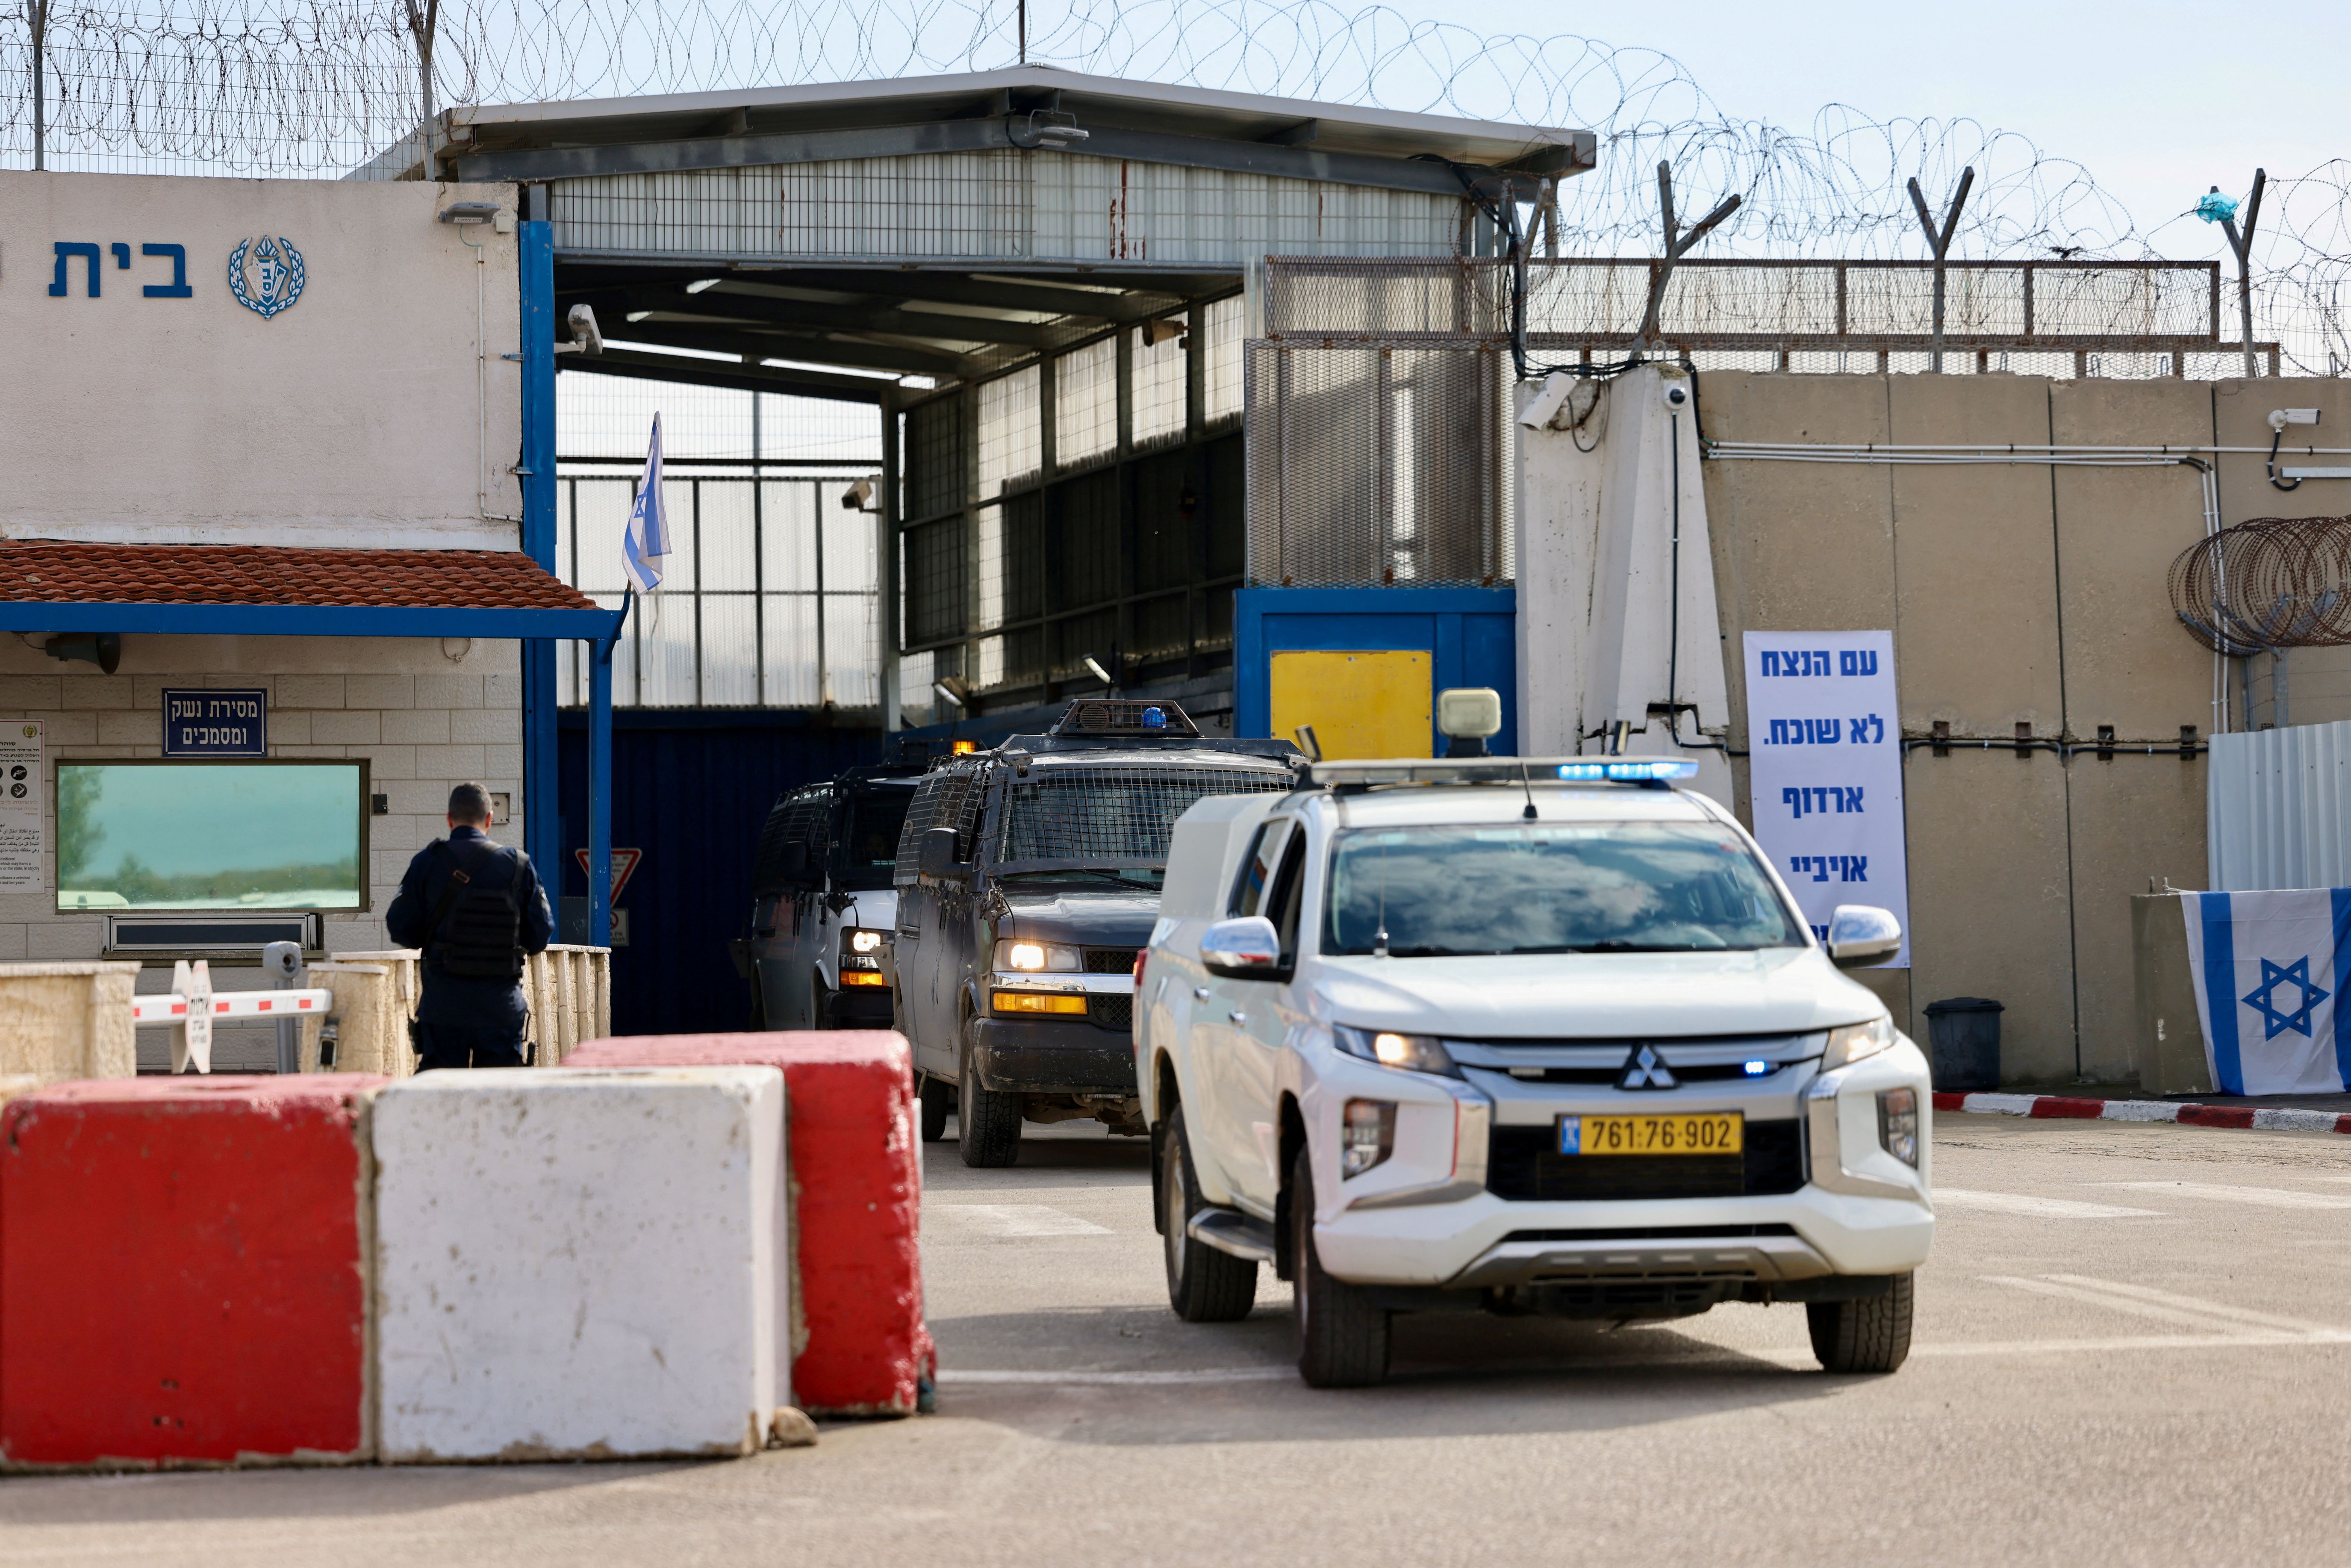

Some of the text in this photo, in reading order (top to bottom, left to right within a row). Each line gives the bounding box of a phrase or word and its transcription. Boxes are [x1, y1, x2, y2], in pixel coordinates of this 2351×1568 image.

[49, 242, 192, 298] בית
[1761, 651, 1878, 677] עם הנצח
[172, 701, 257, 722] מסירת נשק
[183, 728, 247, 744] ומסמכים
[1764, 713, 1884, 745] לא שוכח.
[1782, 787, 1864, 818] ארדוף
[1790, 856, 1868, 882] אויביי
